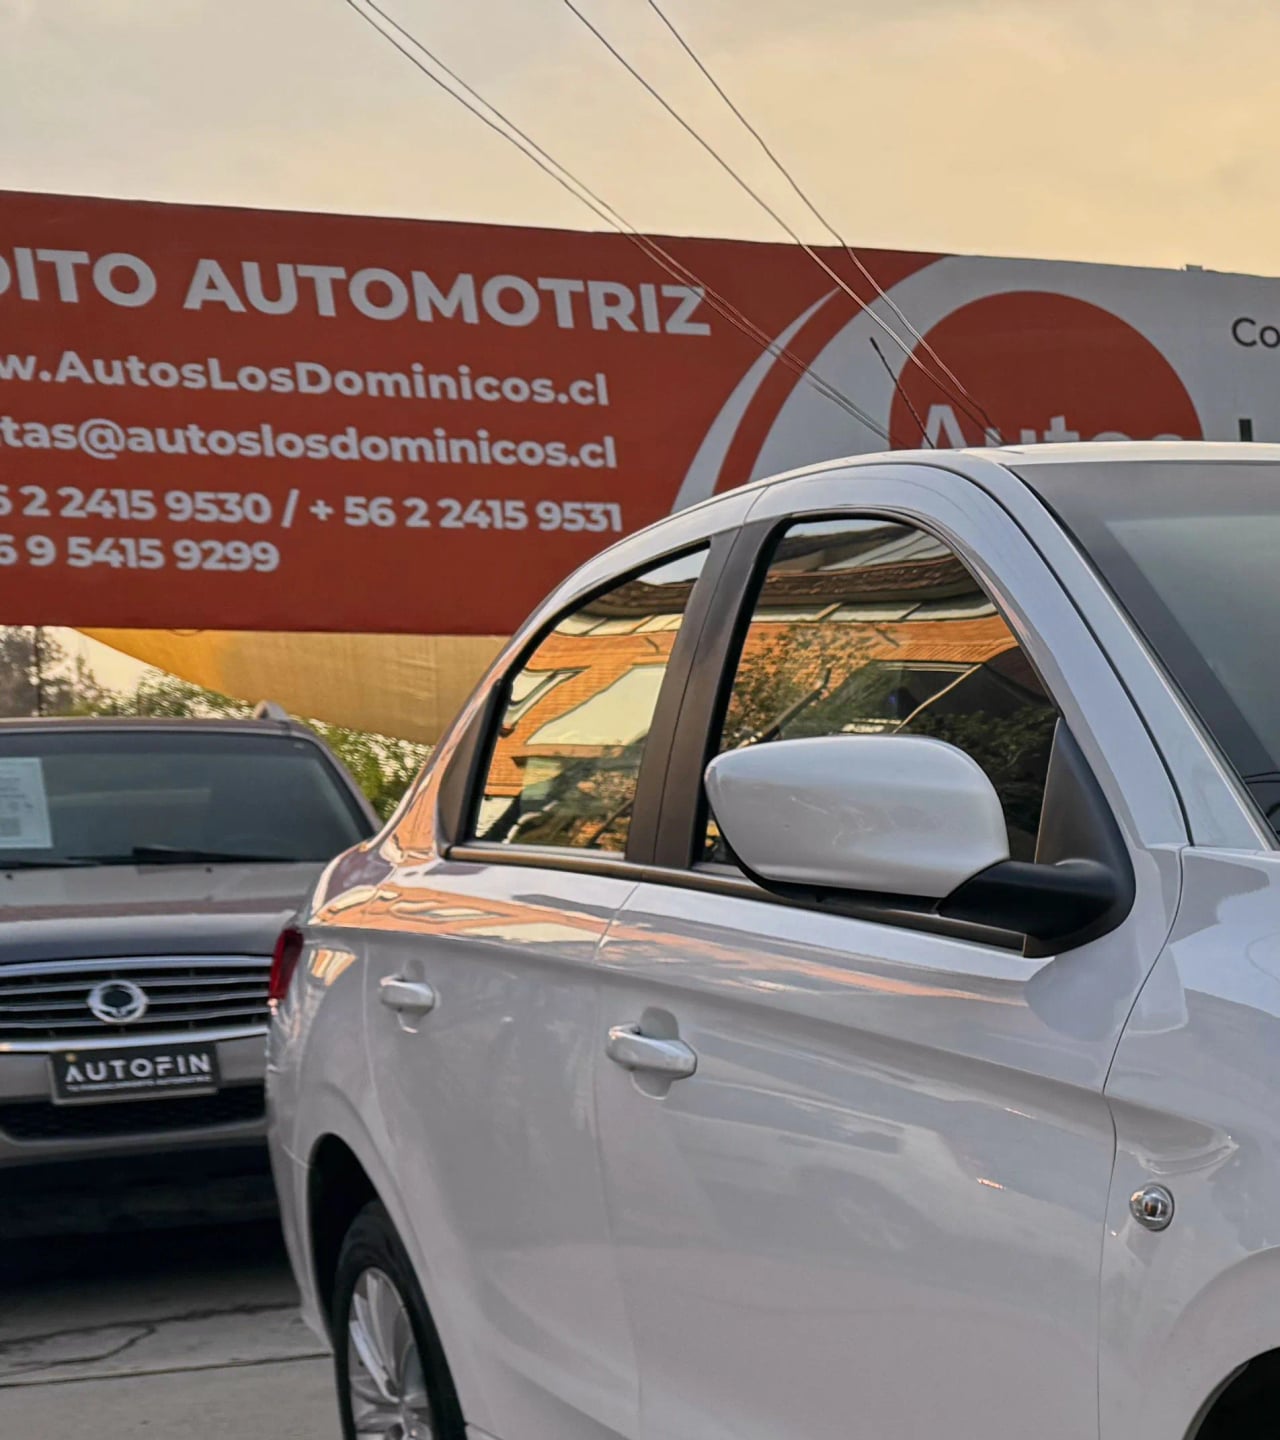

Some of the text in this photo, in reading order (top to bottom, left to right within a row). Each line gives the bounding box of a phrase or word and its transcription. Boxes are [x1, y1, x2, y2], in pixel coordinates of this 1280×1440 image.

[0, 247, 712, 337] ITO AUTOMOTRIZ
[19, 485, 51, 518] 2
[57, 486, 158, 521] 2415
[164, 490, 273, 524] 9530
[309, 499, 334, 521] +
[344, 496, 397, 527] 56
[403, 498, 431, 528] 2
[437, 498, 529, 530] 2415
[535, 501, 623, 532] 9531
[26, 534, 56, 567] 9
[67, 536, 166, 570] 5415
[173, 539, 280, 573] 9299
[65, 1052, 212, 1083] AUTOFIN
